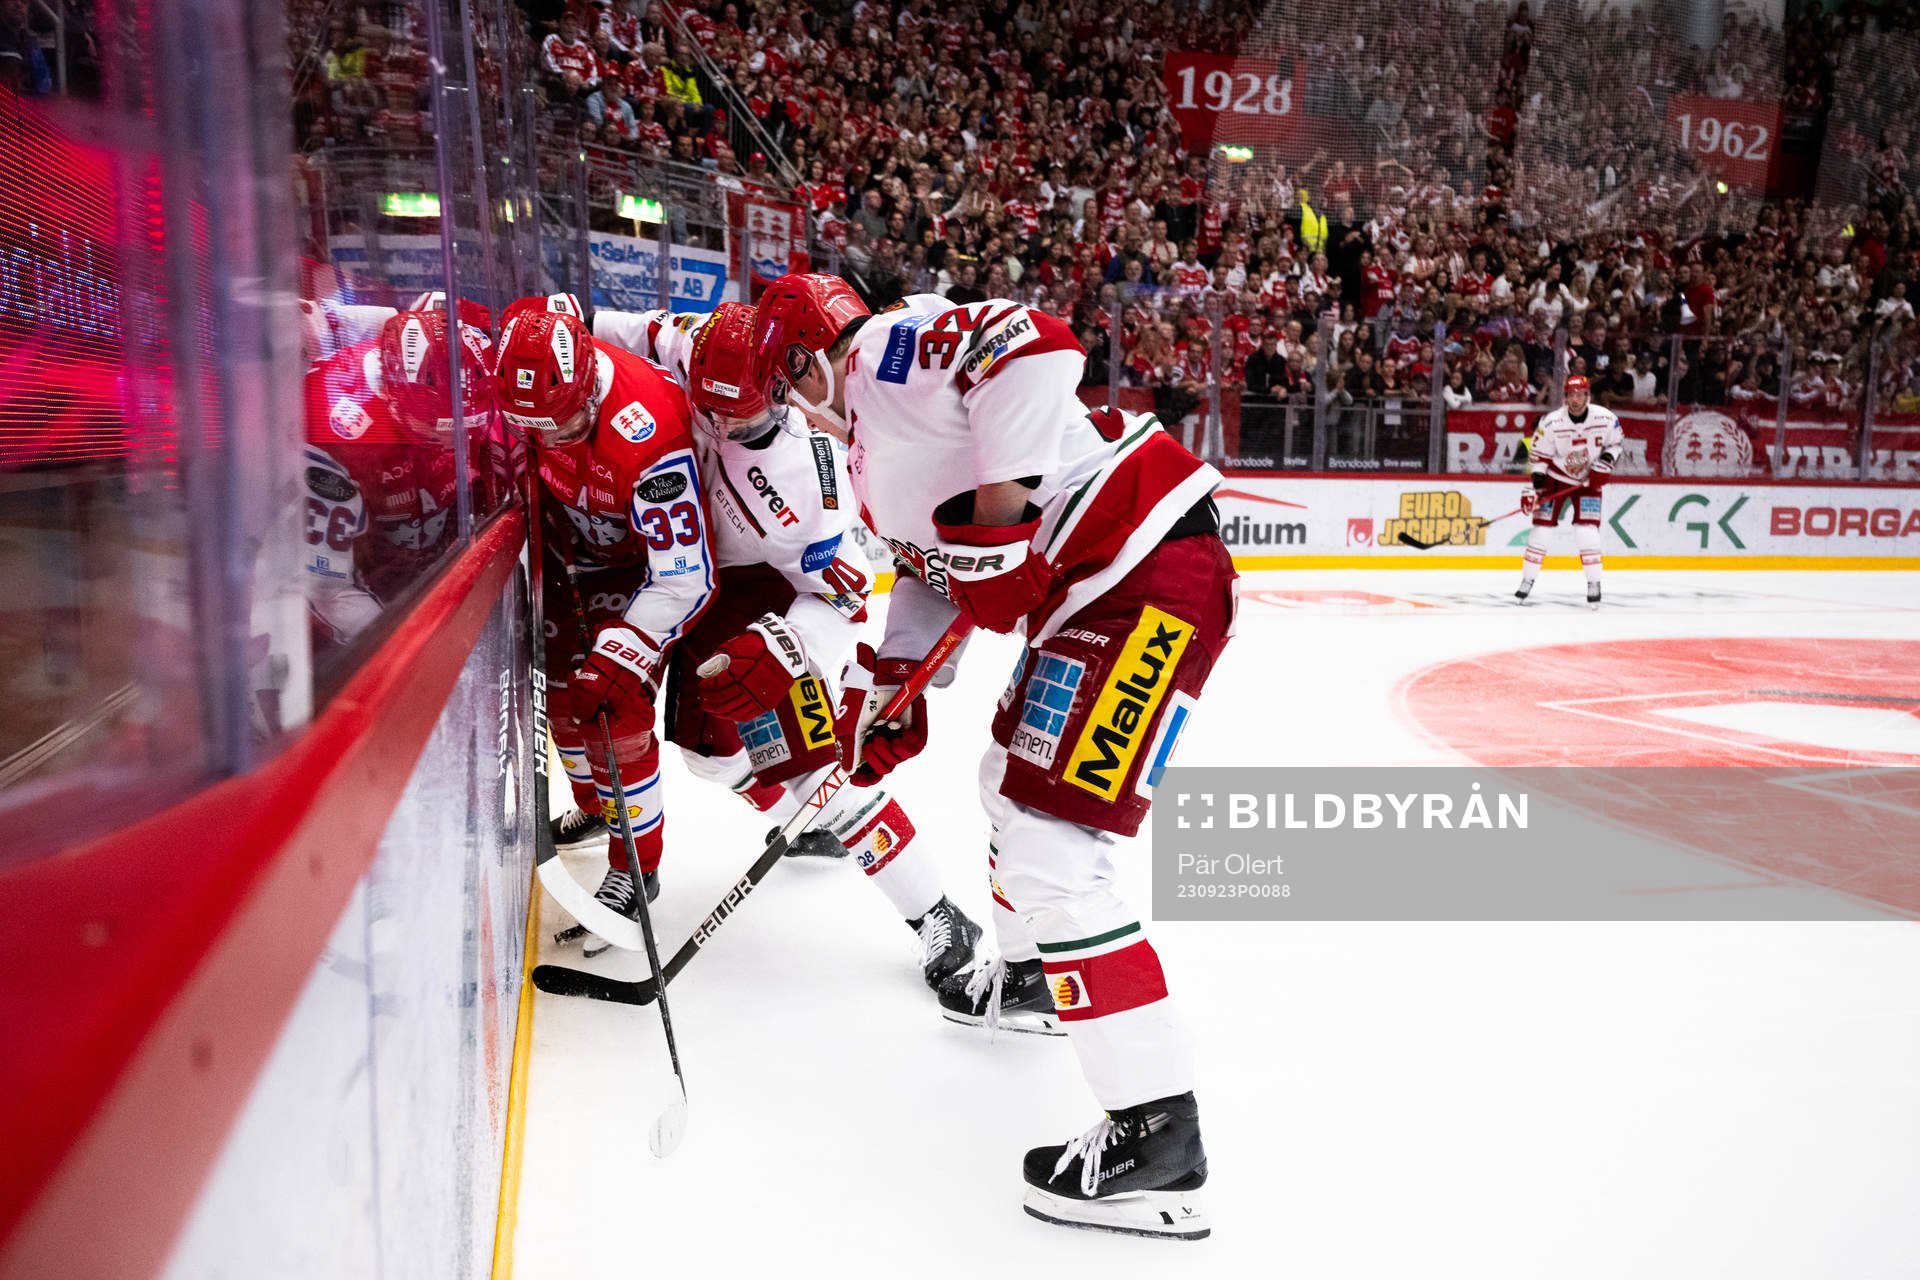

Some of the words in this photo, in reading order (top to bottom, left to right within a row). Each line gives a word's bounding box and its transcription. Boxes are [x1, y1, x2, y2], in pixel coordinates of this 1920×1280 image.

[1176, 65, 1292, 115] 1928
[1677, 113, 1769, 160] 1962
[919, 305, 994, 370] 32
[590, 486, 615, 505] LIUM
[1400, 491, 1463, 518] EURO
[641, 500, 701, 551] 33
[1221, 516, 1306, 545] dium
[1377, 516, 1485, 547] JACKPOT
[822, 557, 867, 594] 10
[1055, 628, 1110, 648] AUER
[532, 668, 548, 777] BAUER
[1075, 621, 1182, 792] Malux
[857, 850, 876, 868] Q8
